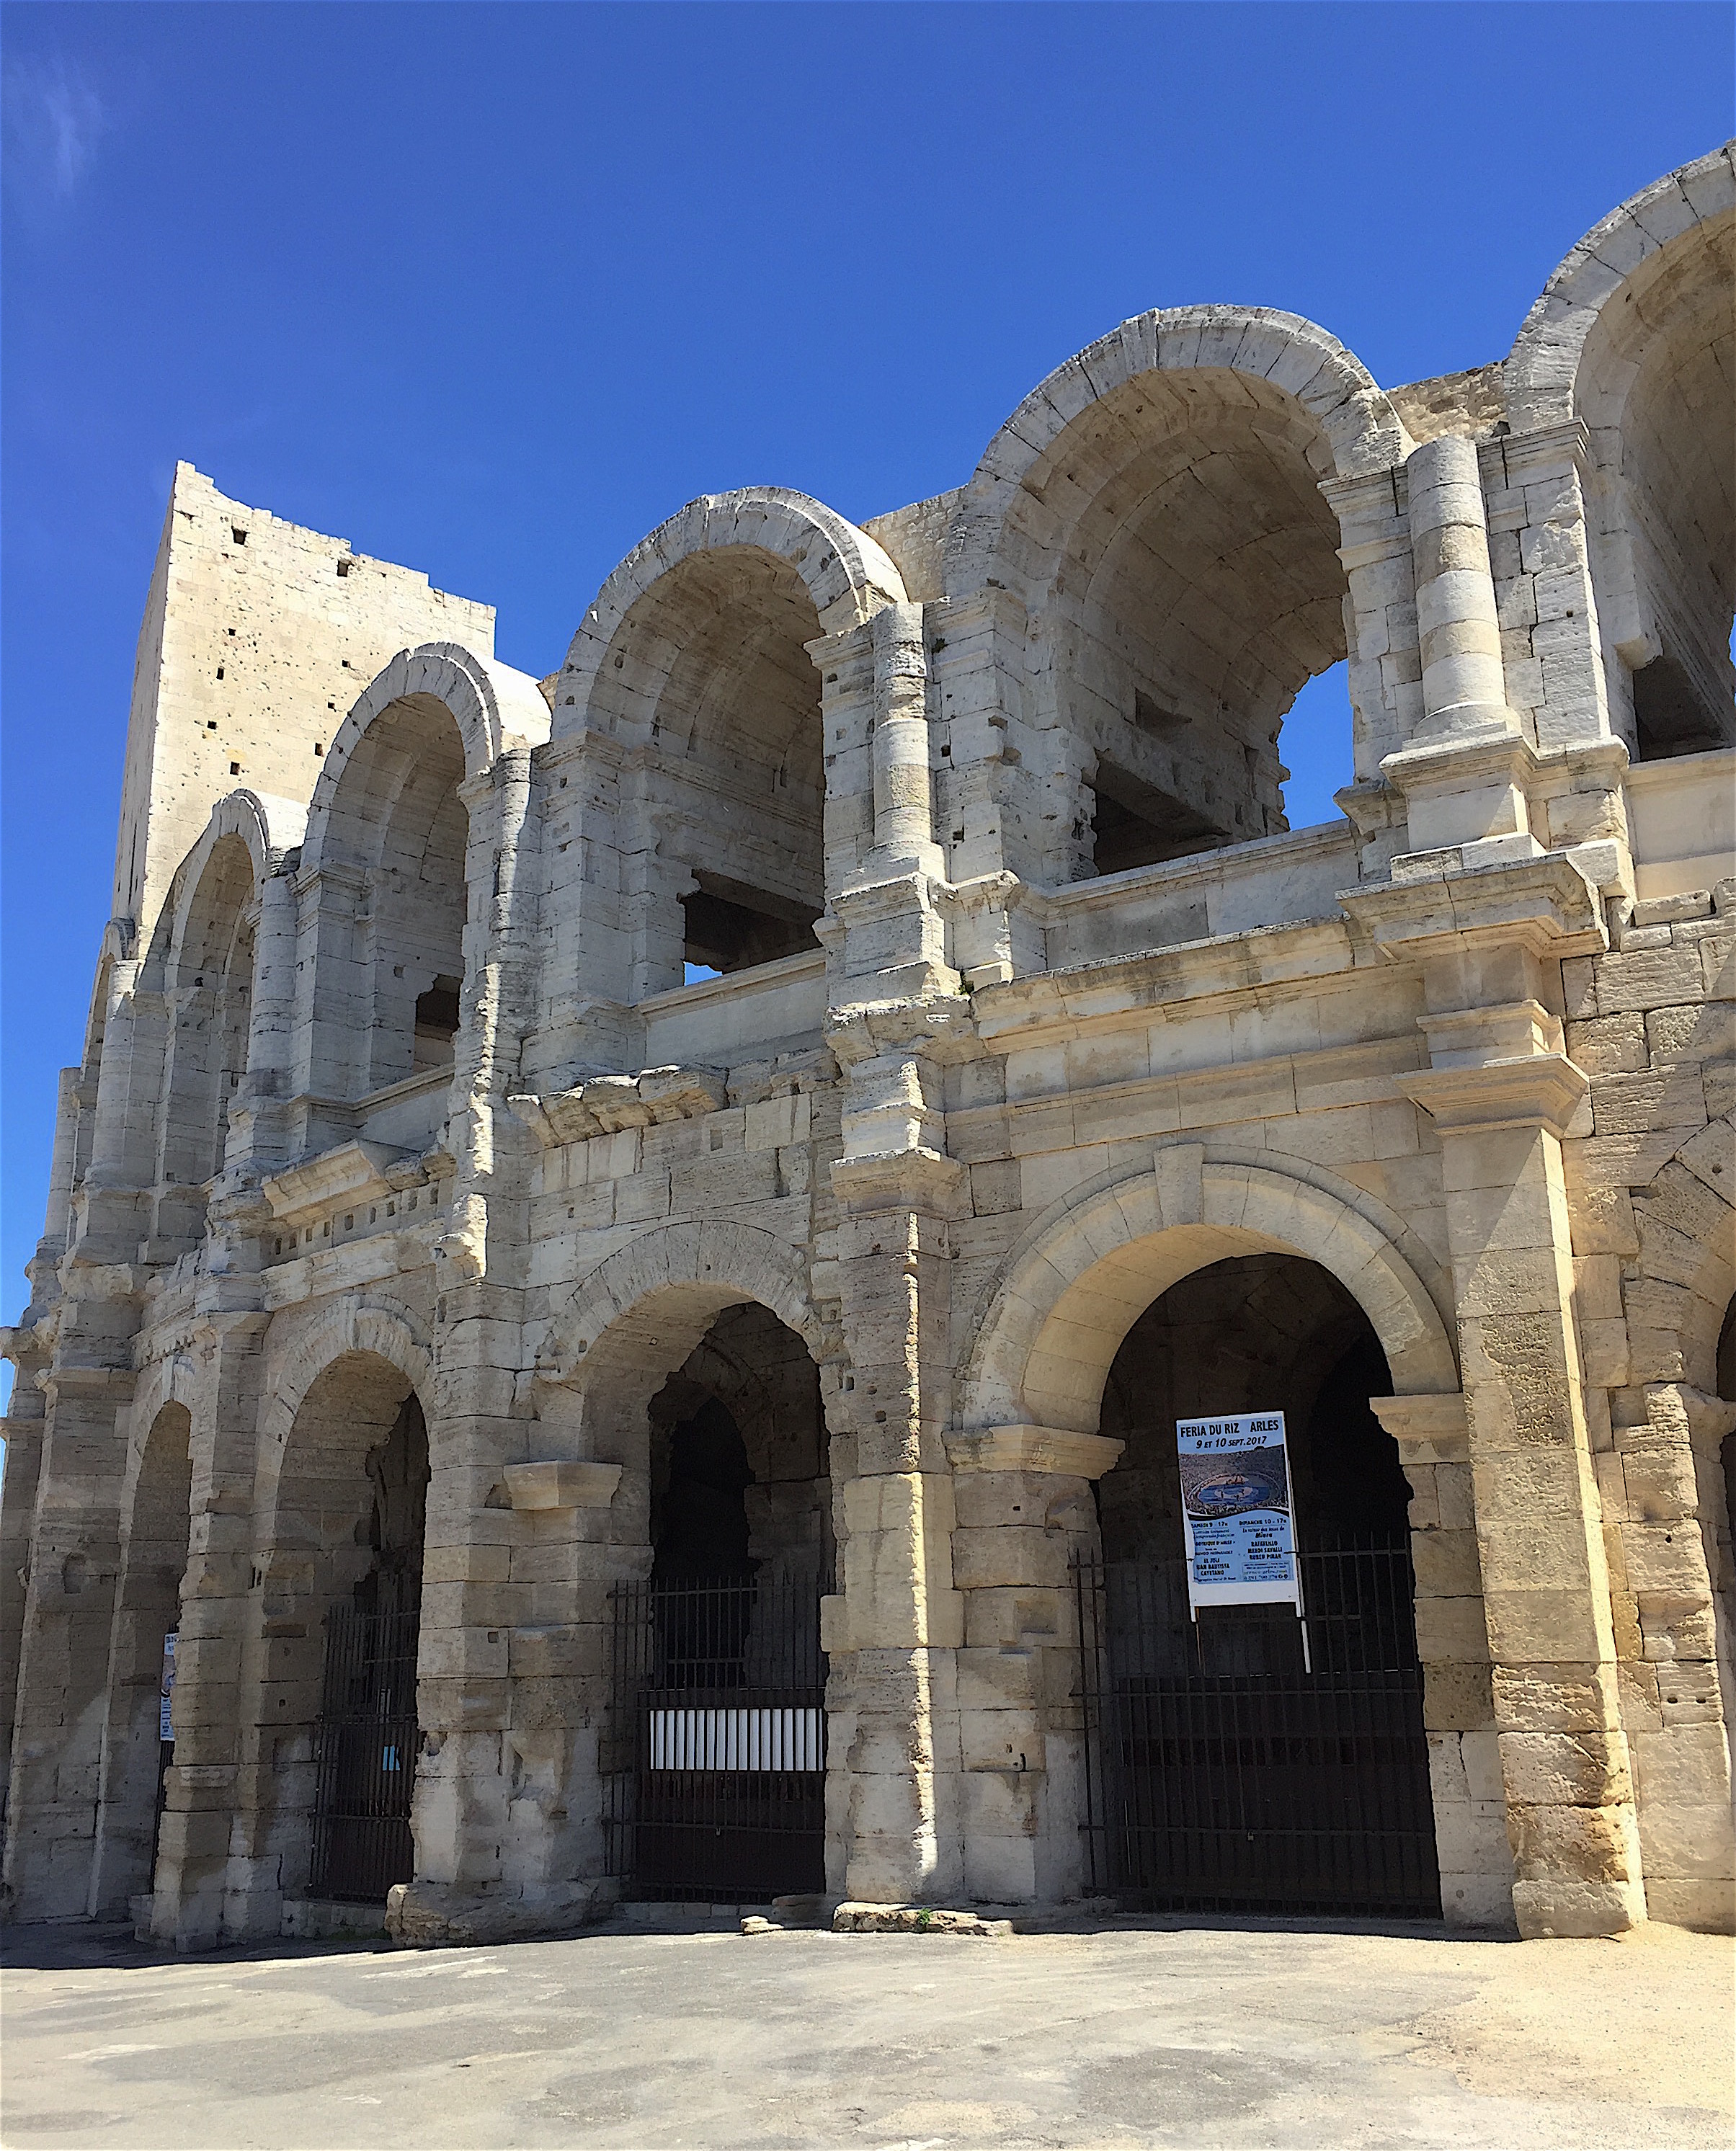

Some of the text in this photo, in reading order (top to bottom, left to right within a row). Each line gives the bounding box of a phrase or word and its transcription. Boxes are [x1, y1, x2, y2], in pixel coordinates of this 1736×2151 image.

[1180, 1420, 1279, 1438] FERIA DU RIZ ARLES
[1196, 1440, 1202, 1448] 9
[1216, 1438, 1227, 1448] 10
